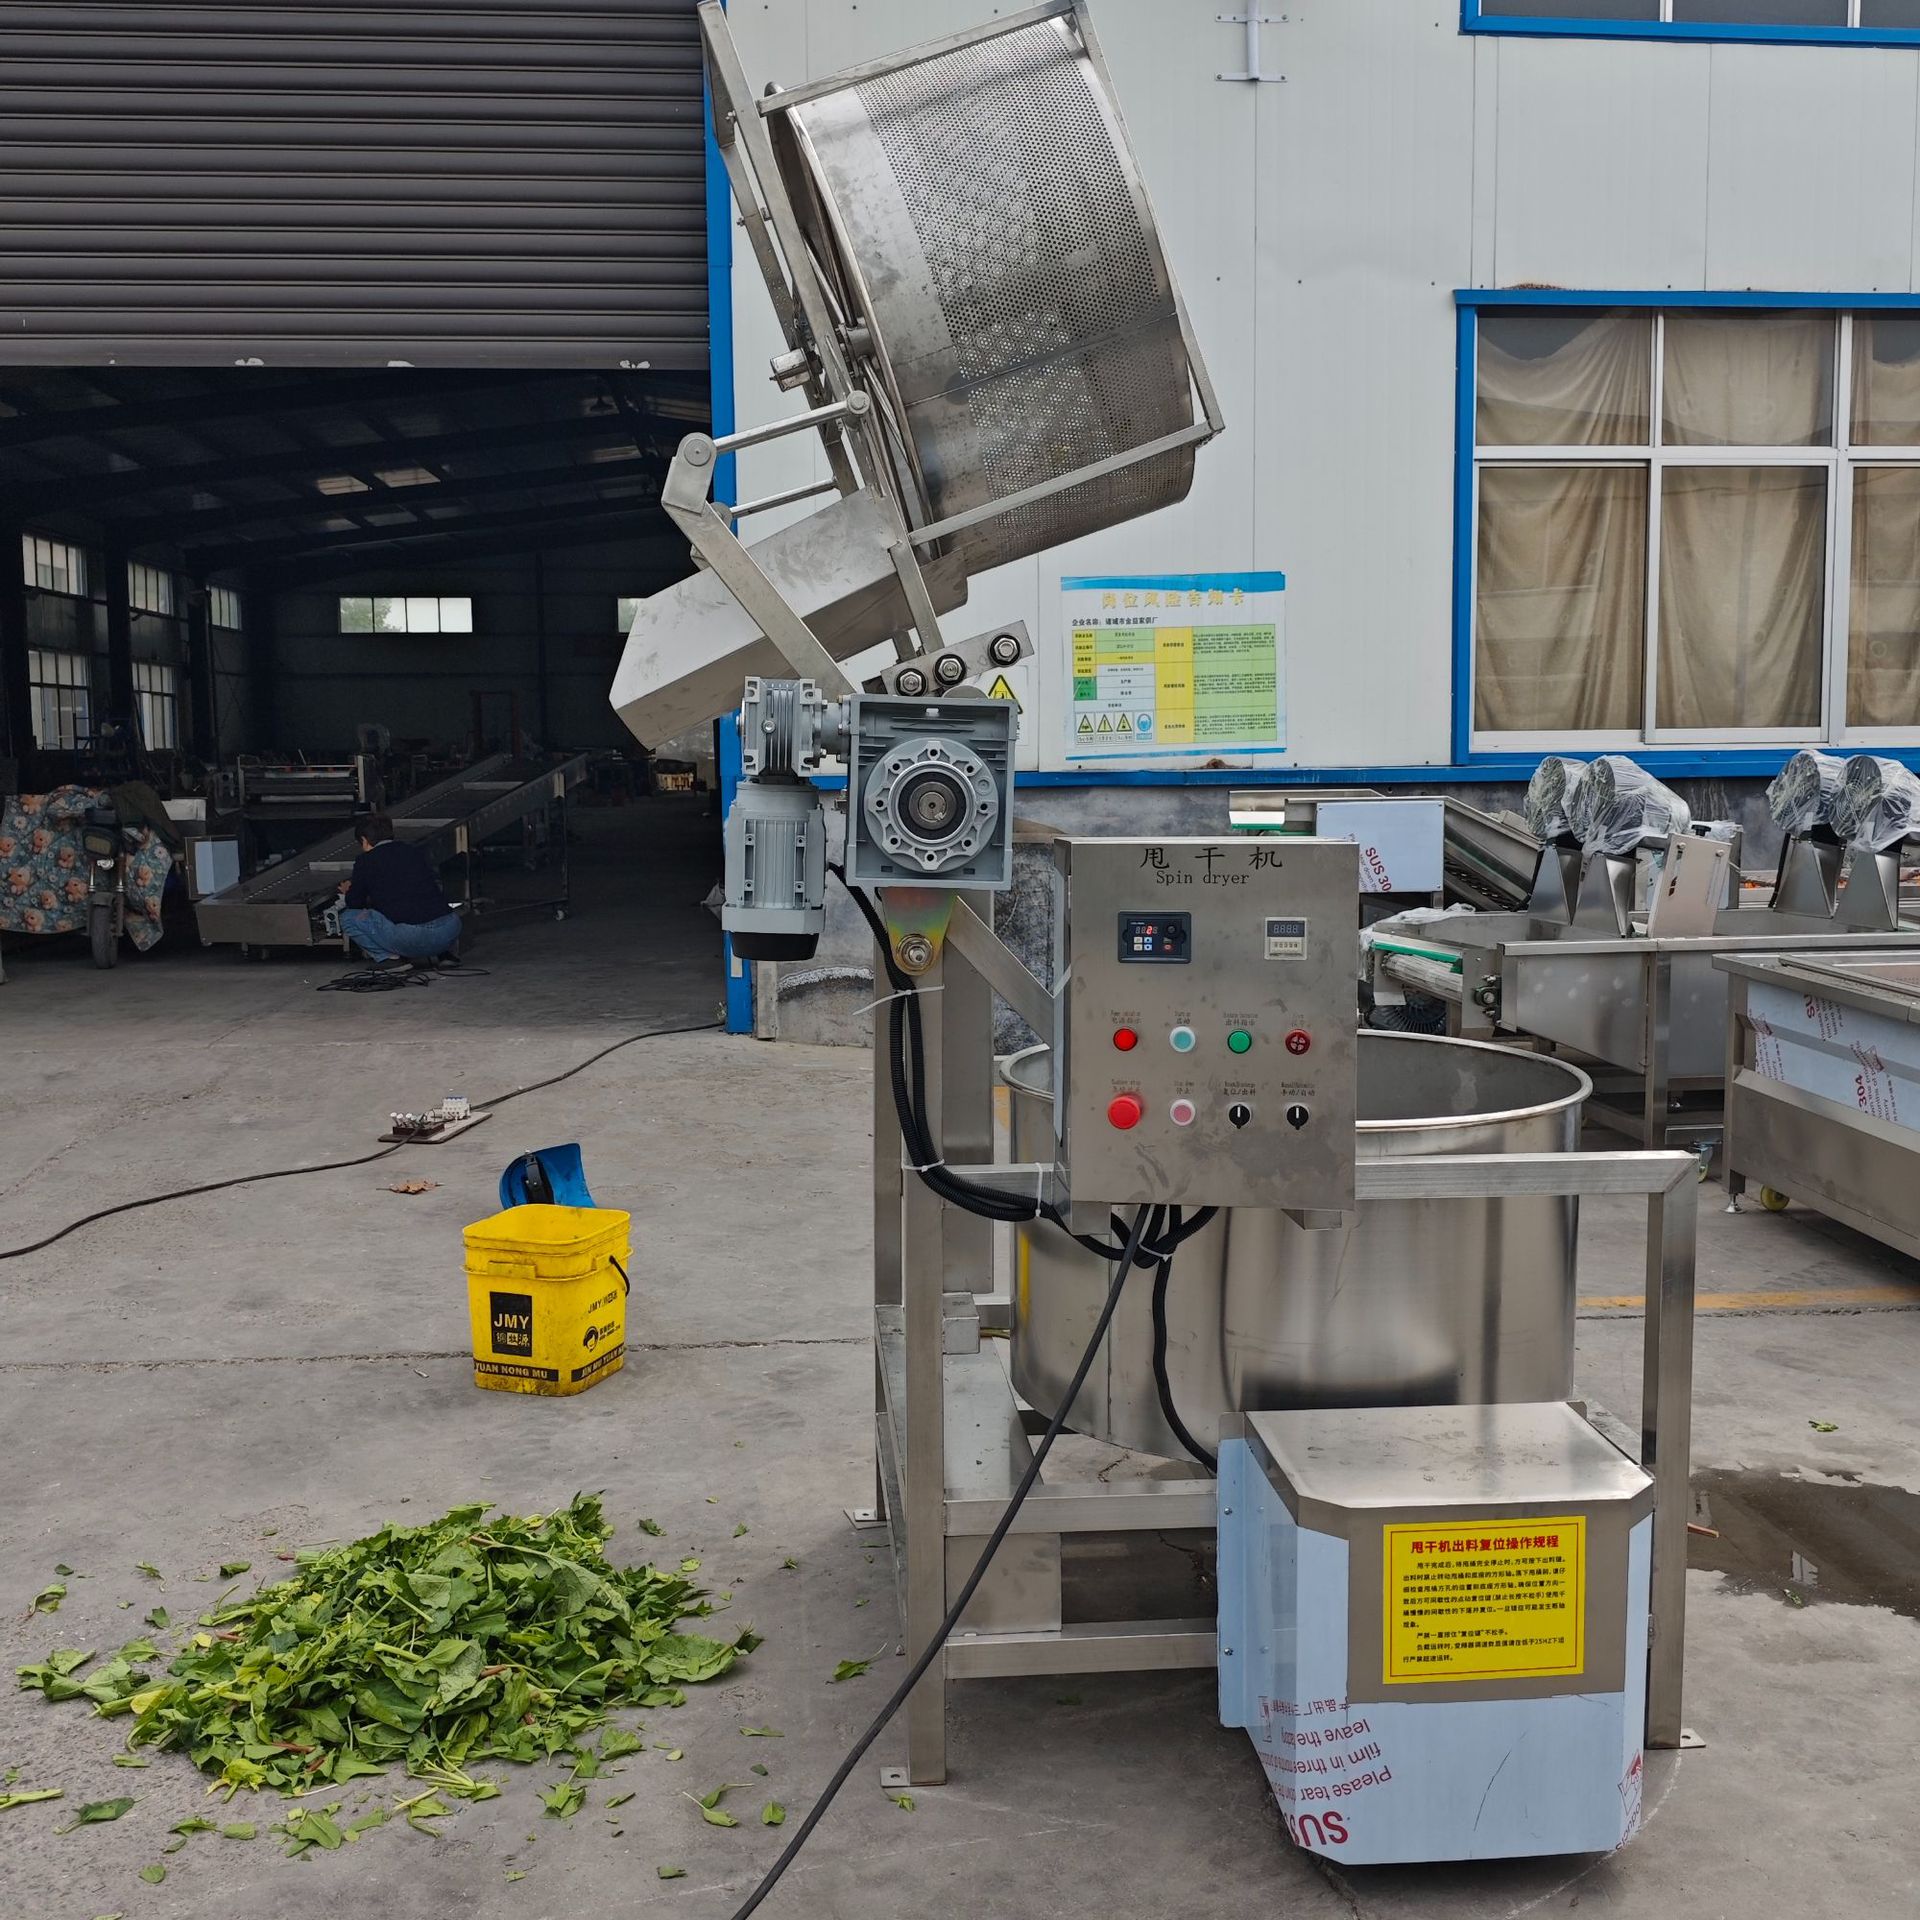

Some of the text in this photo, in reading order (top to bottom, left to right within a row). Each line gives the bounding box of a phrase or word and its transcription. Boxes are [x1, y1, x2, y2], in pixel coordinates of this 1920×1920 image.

[1365, 847, 1385, 875] SUS
[1156, 870, 1250, 886] Spin dryer
[494, 1313, 529, 1329] JMY
[501, 1367, 529, 1377] NONG
[532, 1370, 548, 1378] MU
[1410, 1535, 1559, 1553] 甩干机出料复位操作规程
[1296, 1718, 1371, 1748] leave the
[1347, 1742, 1382, 1765] film
[1329, 1755, 1346, 1772] in
[1332, 1764, 1392, 1798] Please
[1300, 1786, 1330, 1803] tear
